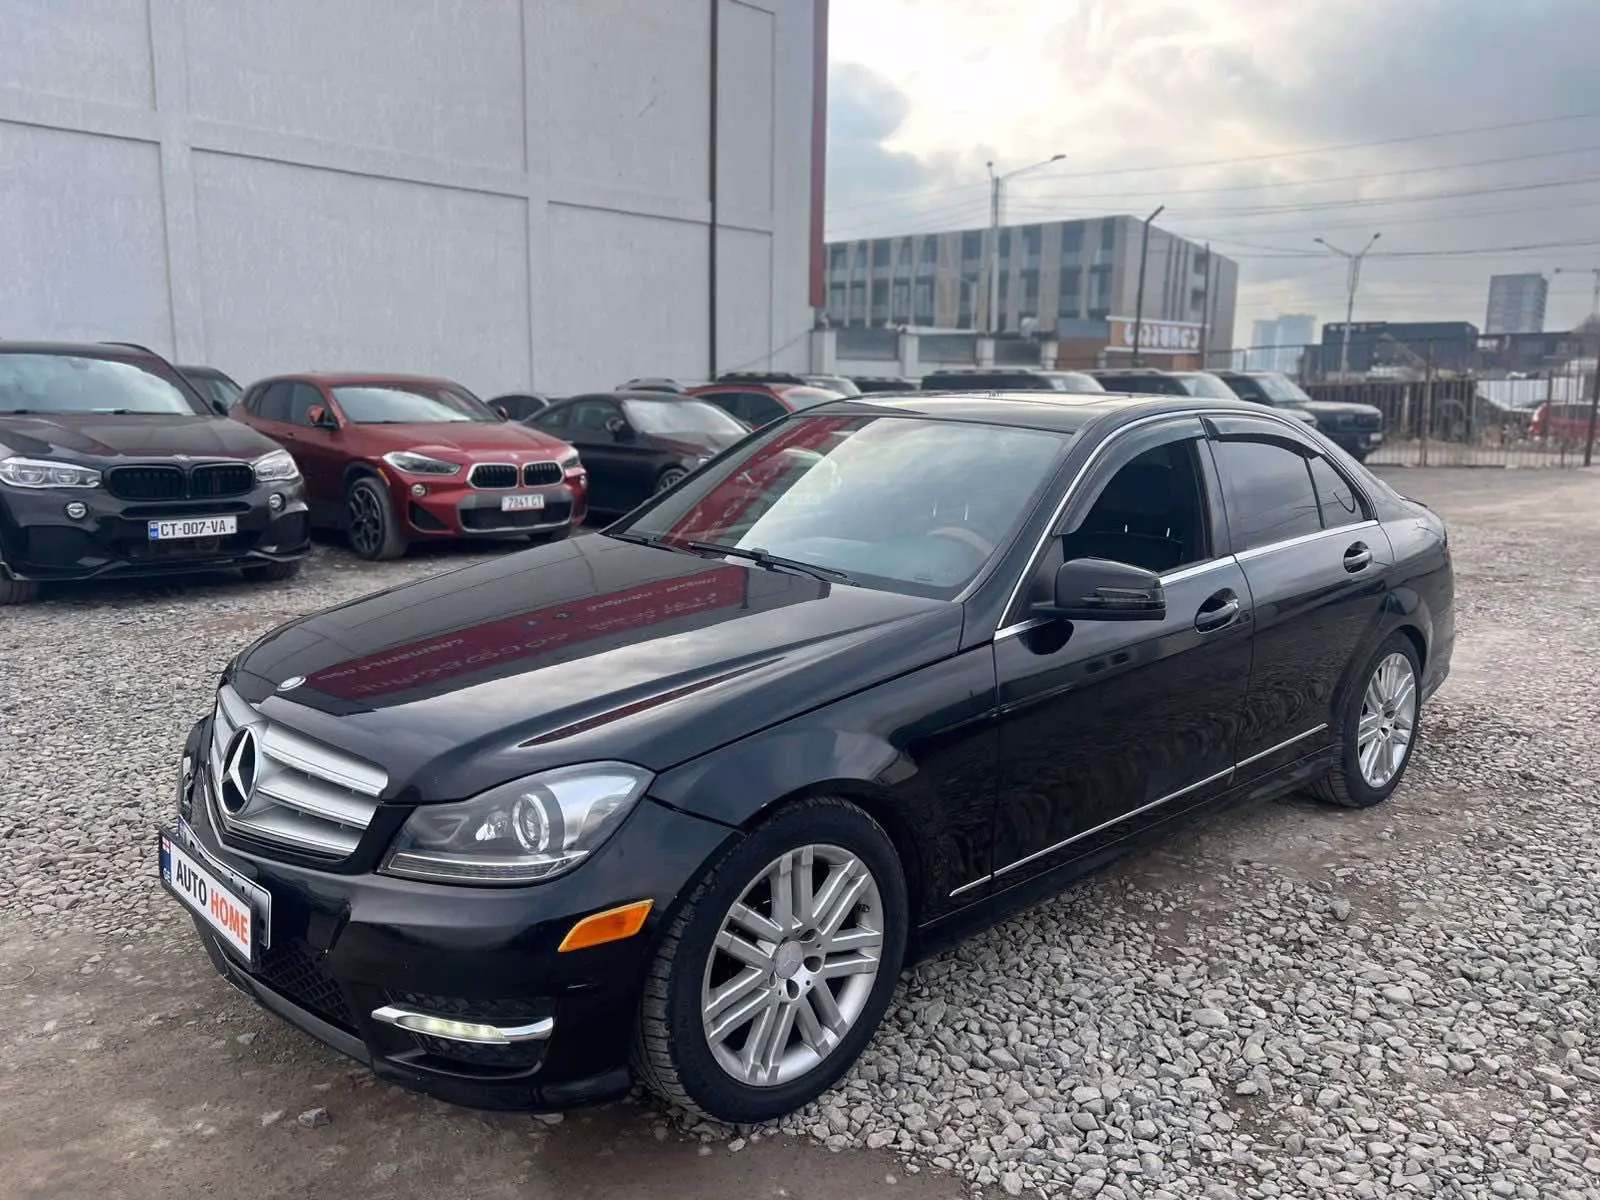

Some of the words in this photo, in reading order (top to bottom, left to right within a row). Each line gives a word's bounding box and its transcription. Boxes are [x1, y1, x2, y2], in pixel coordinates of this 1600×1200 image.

[160, 520, 226, 536] CT-007-VA
[176, 859, 207, 907] AUTO
[210, 887, 249, 945] HOME
